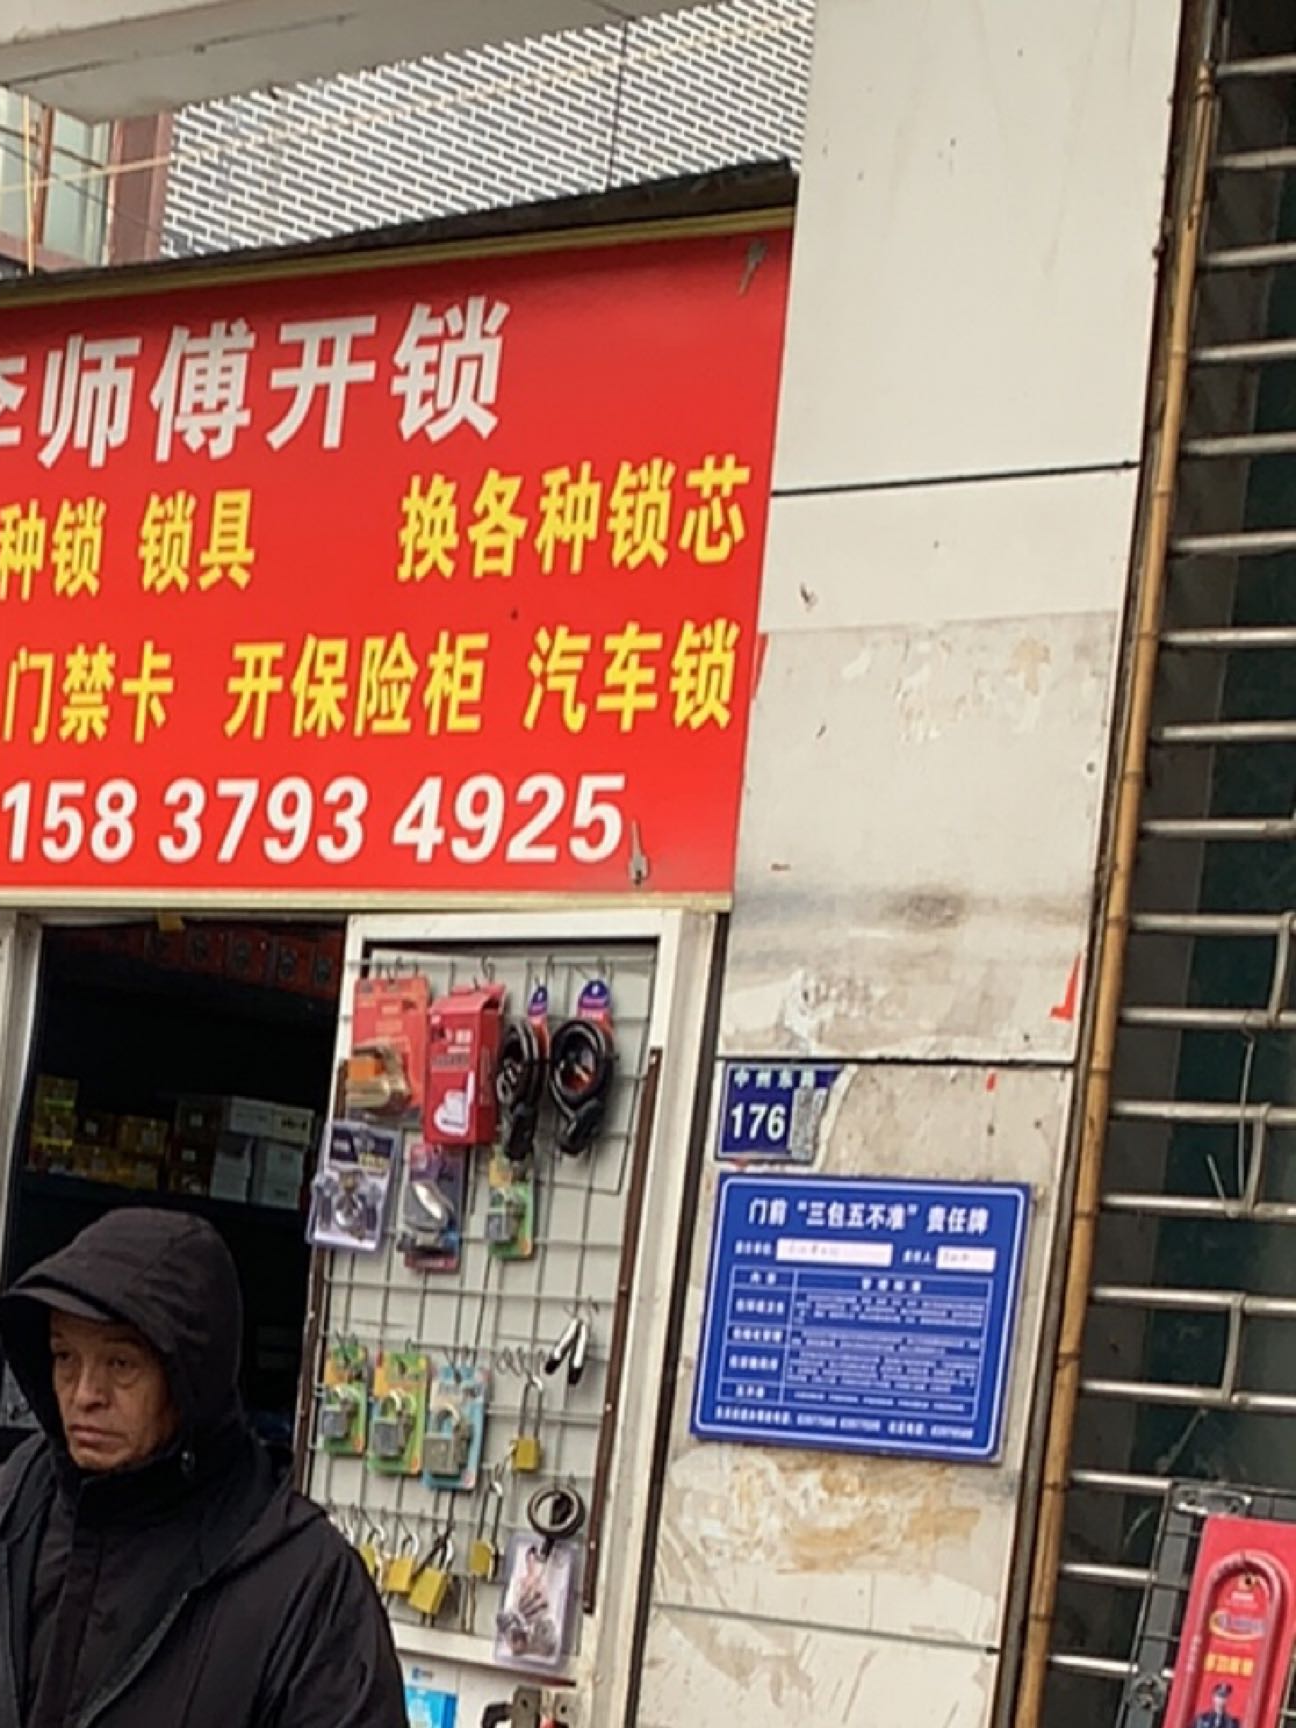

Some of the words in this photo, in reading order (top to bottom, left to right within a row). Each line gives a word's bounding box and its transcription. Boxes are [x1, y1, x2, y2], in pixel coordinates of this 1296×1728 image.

[138, 488, 255, 593] 锁具
[396, 454, 751, 582] 换各种锁芯
[3, 640, 174, 744] 门禁卡
[223, 628, 490, 740] 开保险柜
[522, 617, 740, 733] 汽车锁
[2, 777, 137, 862] 158
[158, 774, 369, 864] 3793
[392, 773, 626, 864] 4925
